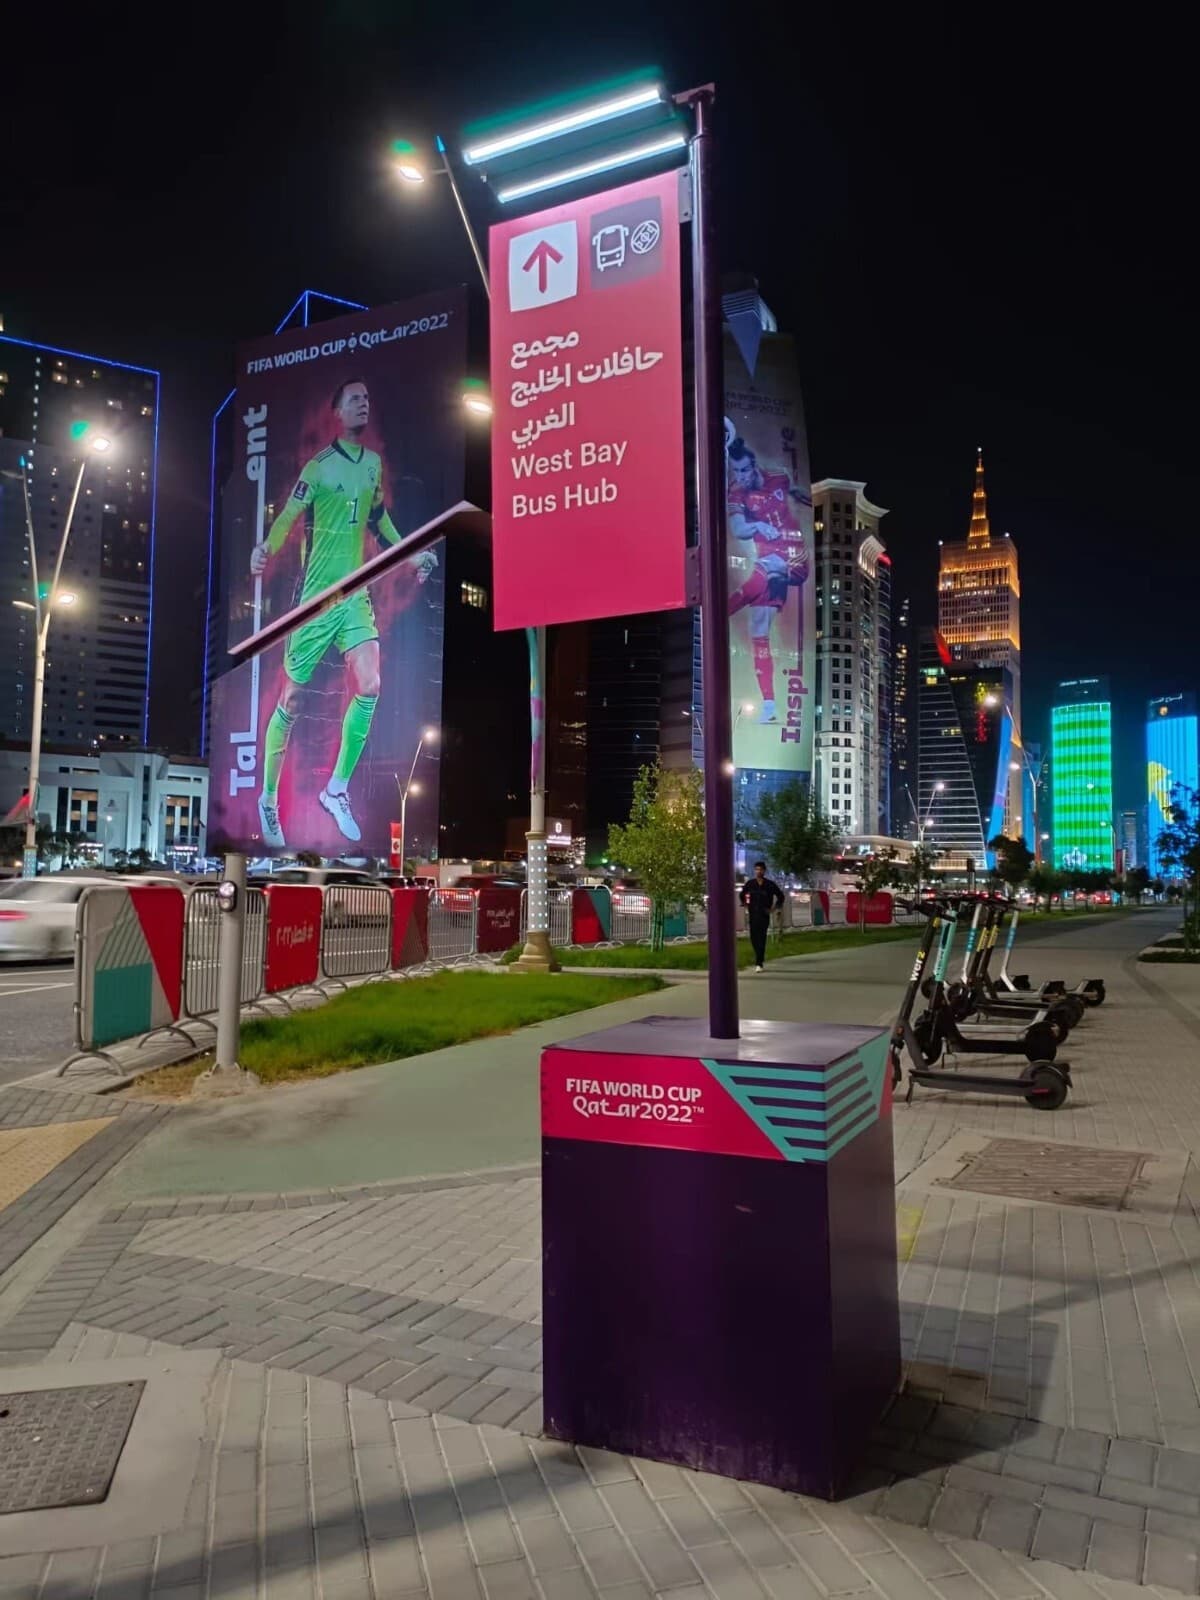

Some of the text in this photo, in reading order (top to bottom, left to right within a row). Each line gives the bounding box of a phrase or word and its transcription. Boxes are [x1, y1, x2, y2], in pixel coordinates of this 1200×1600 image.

[247, 356, 273, 374] FIFA
[273, 345, 319, 367] WORLD
[321, 339, 347, 356] CUP
[510, 330, 579, 369] مجمع
[510, 346, 663, 407] حافلات الخليج
[511, 402, 575, 449] الغربي
[511, 440, 628, 479] West Bay
[348, 497, 359, 524] 1
[512, 477, 618, 518] Bus Hub
[566, 1077, 702, 1102] FIFA WORLD CUP
